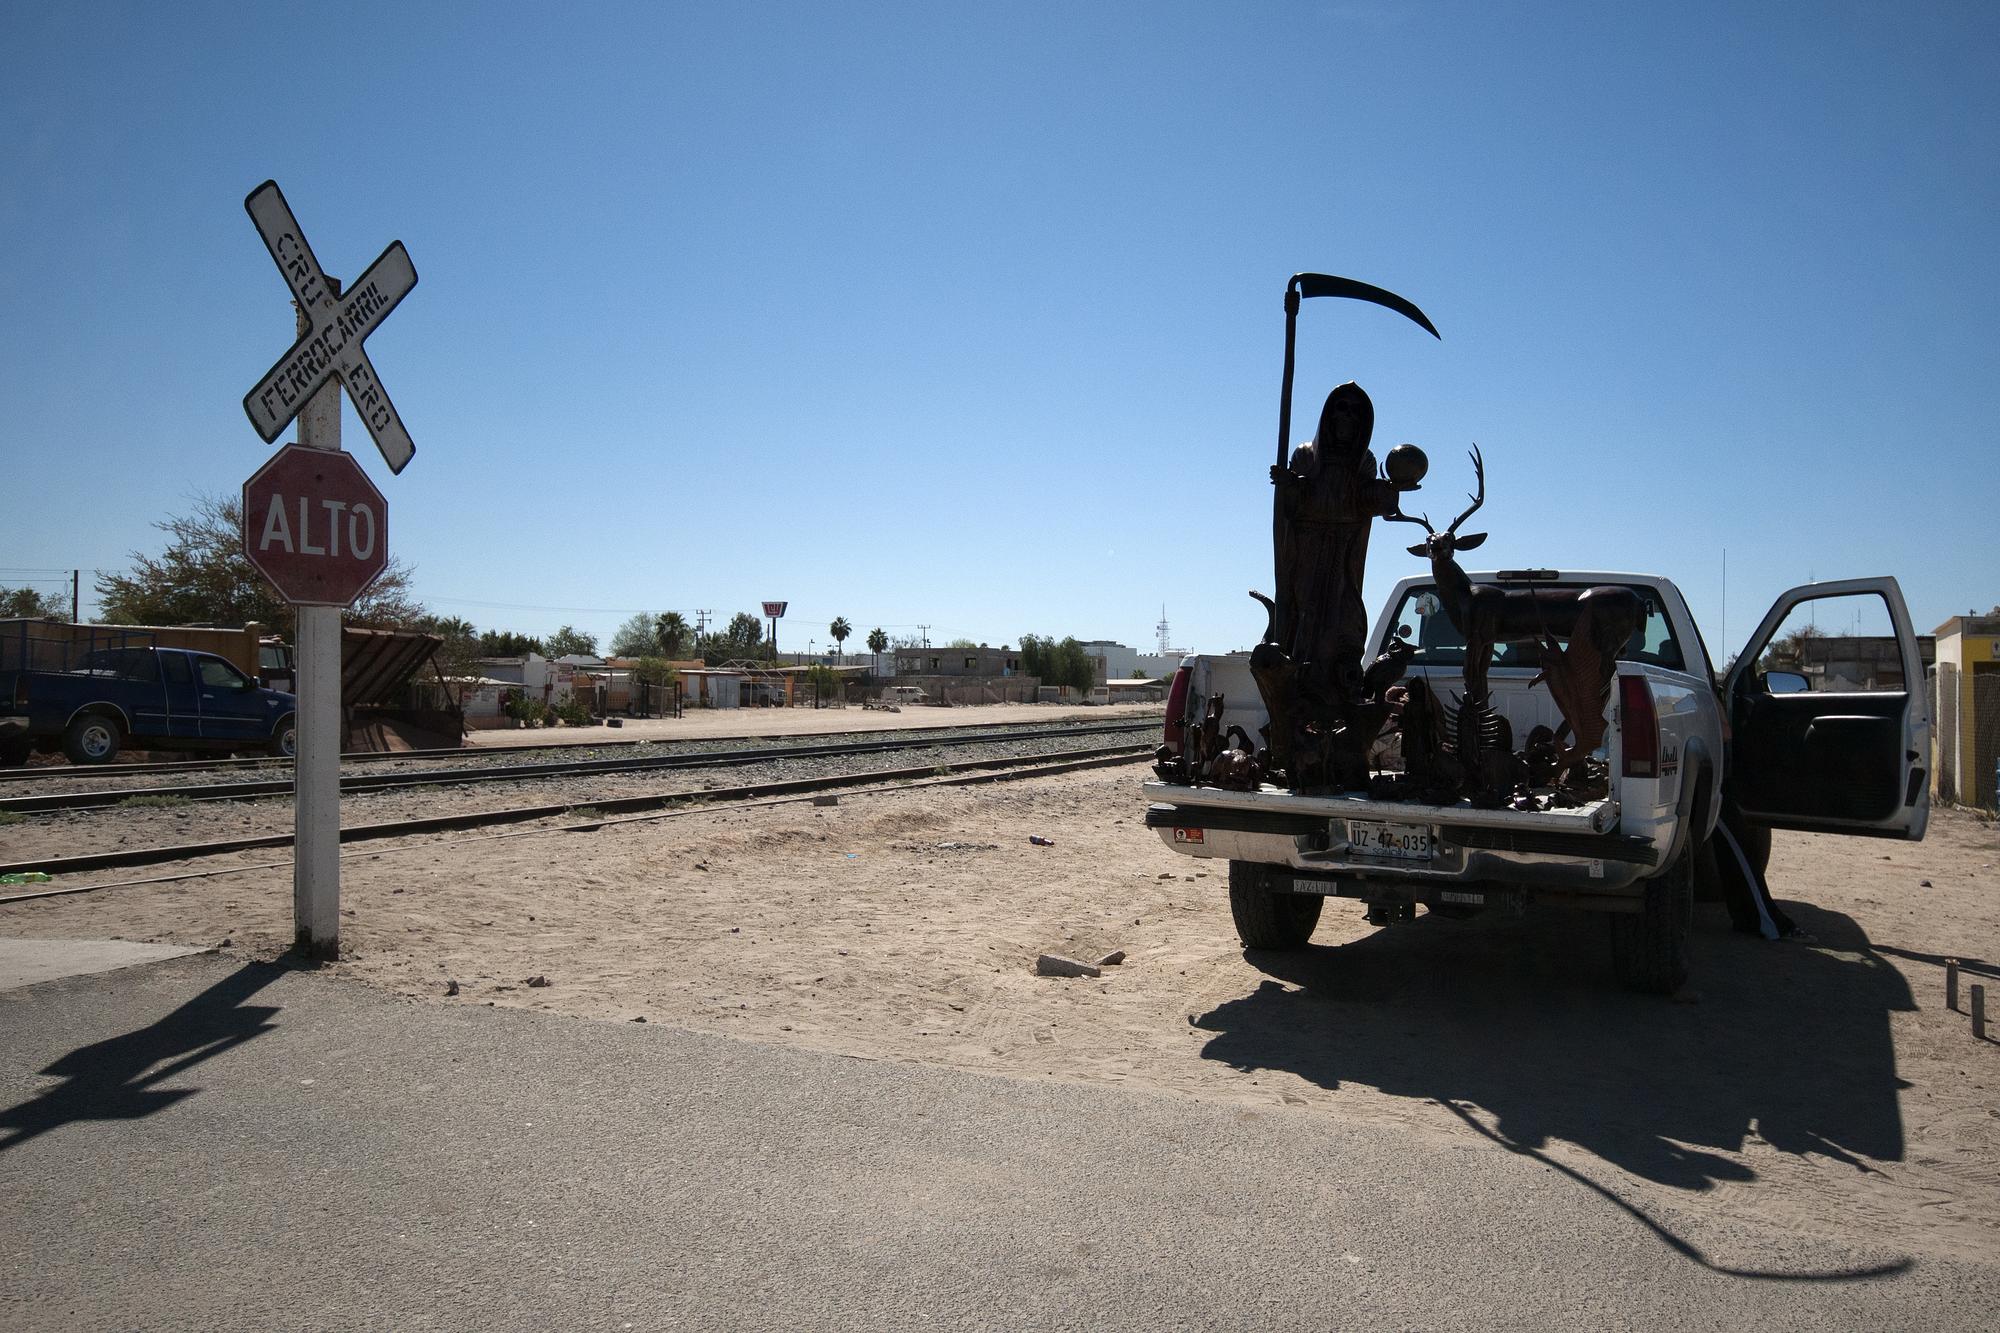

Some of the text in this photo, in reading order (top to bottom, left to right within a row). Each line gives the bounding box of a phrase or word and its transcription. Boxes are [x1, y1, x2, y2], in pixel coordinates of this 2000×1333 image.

[277, 233, 323, 306] CRU
[260, 281, 389, 421] FERROCARRIL
[259, 494, 375, 560] ALTO
